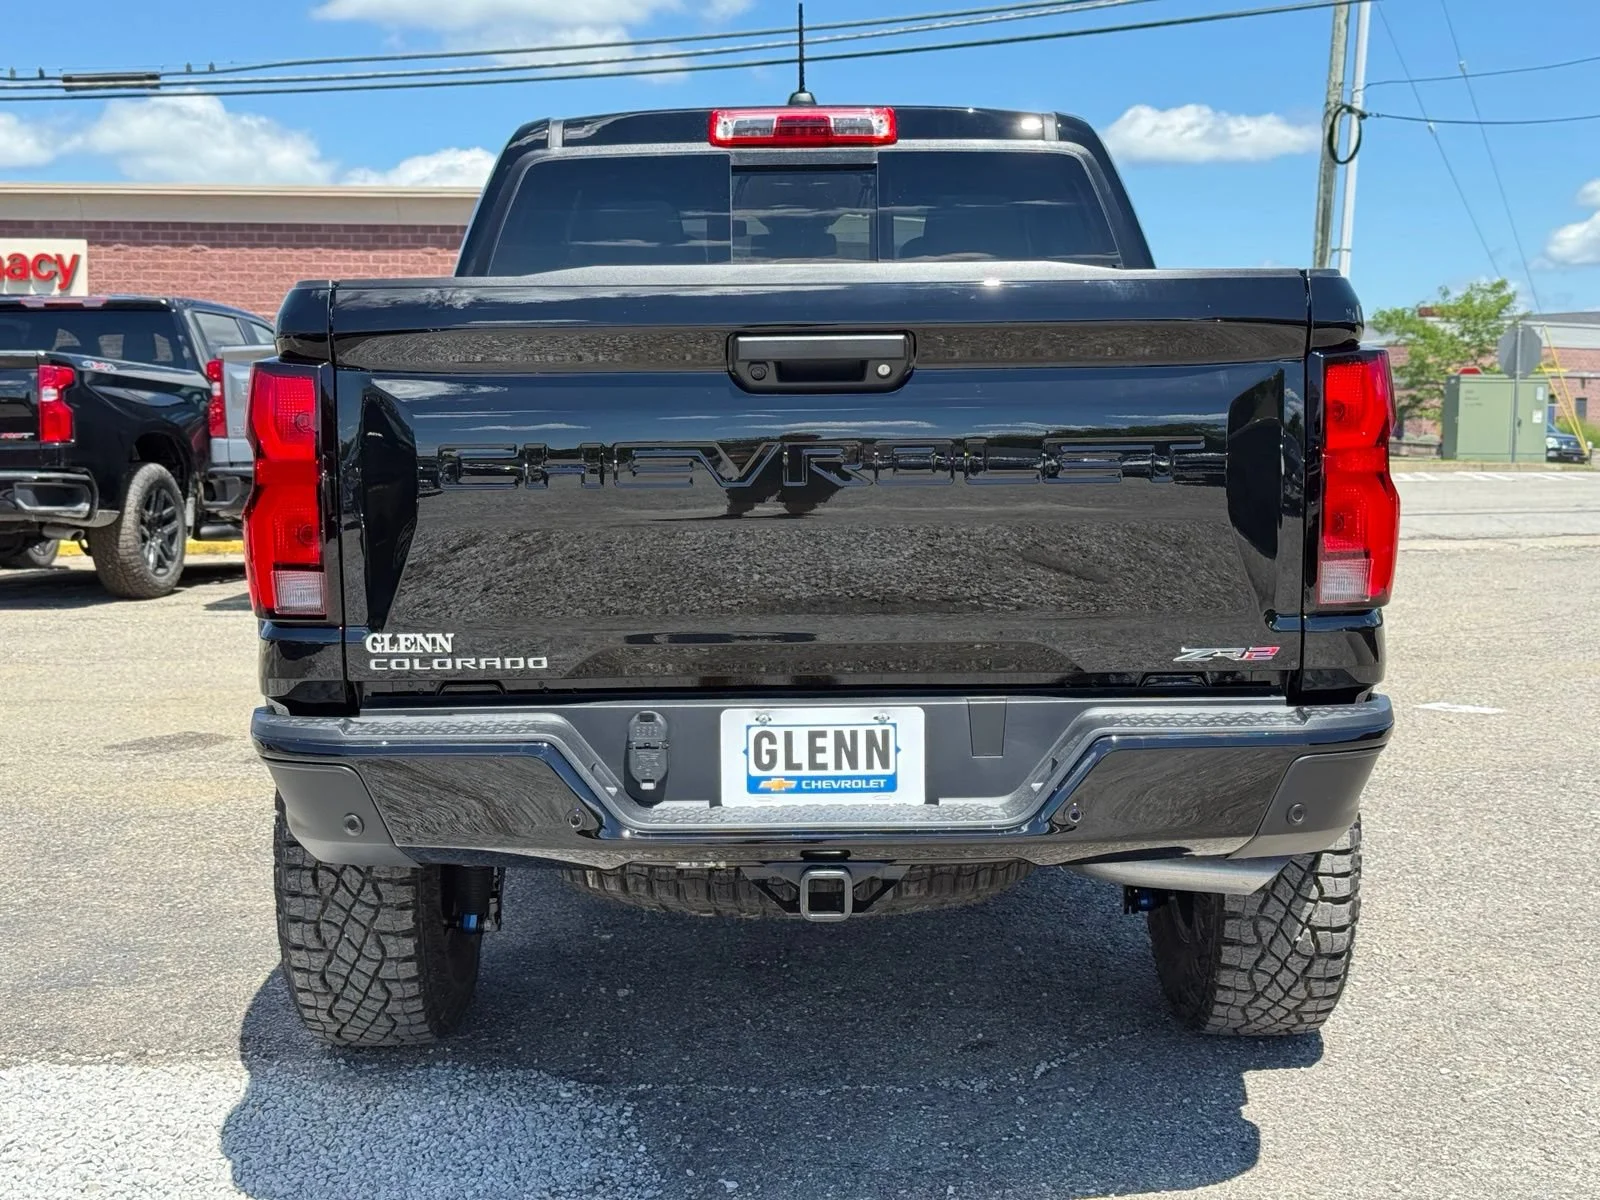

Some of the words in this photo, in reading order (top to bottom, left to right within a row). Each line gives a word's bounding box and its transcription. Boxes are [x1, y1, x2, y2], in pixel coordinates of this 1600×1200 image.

[0, 252, 80, 291] acy
[438, 440, 1205, 489] CHEVROLET
[366, 633, 454, 653] GLENN
[369, 656, 548, 670] COLORADO
[1173, 646, 1281, 662] ZR2
[753, 729, 890, 772] GLENN
[801, 779, 887, 789] CHEVROLET
